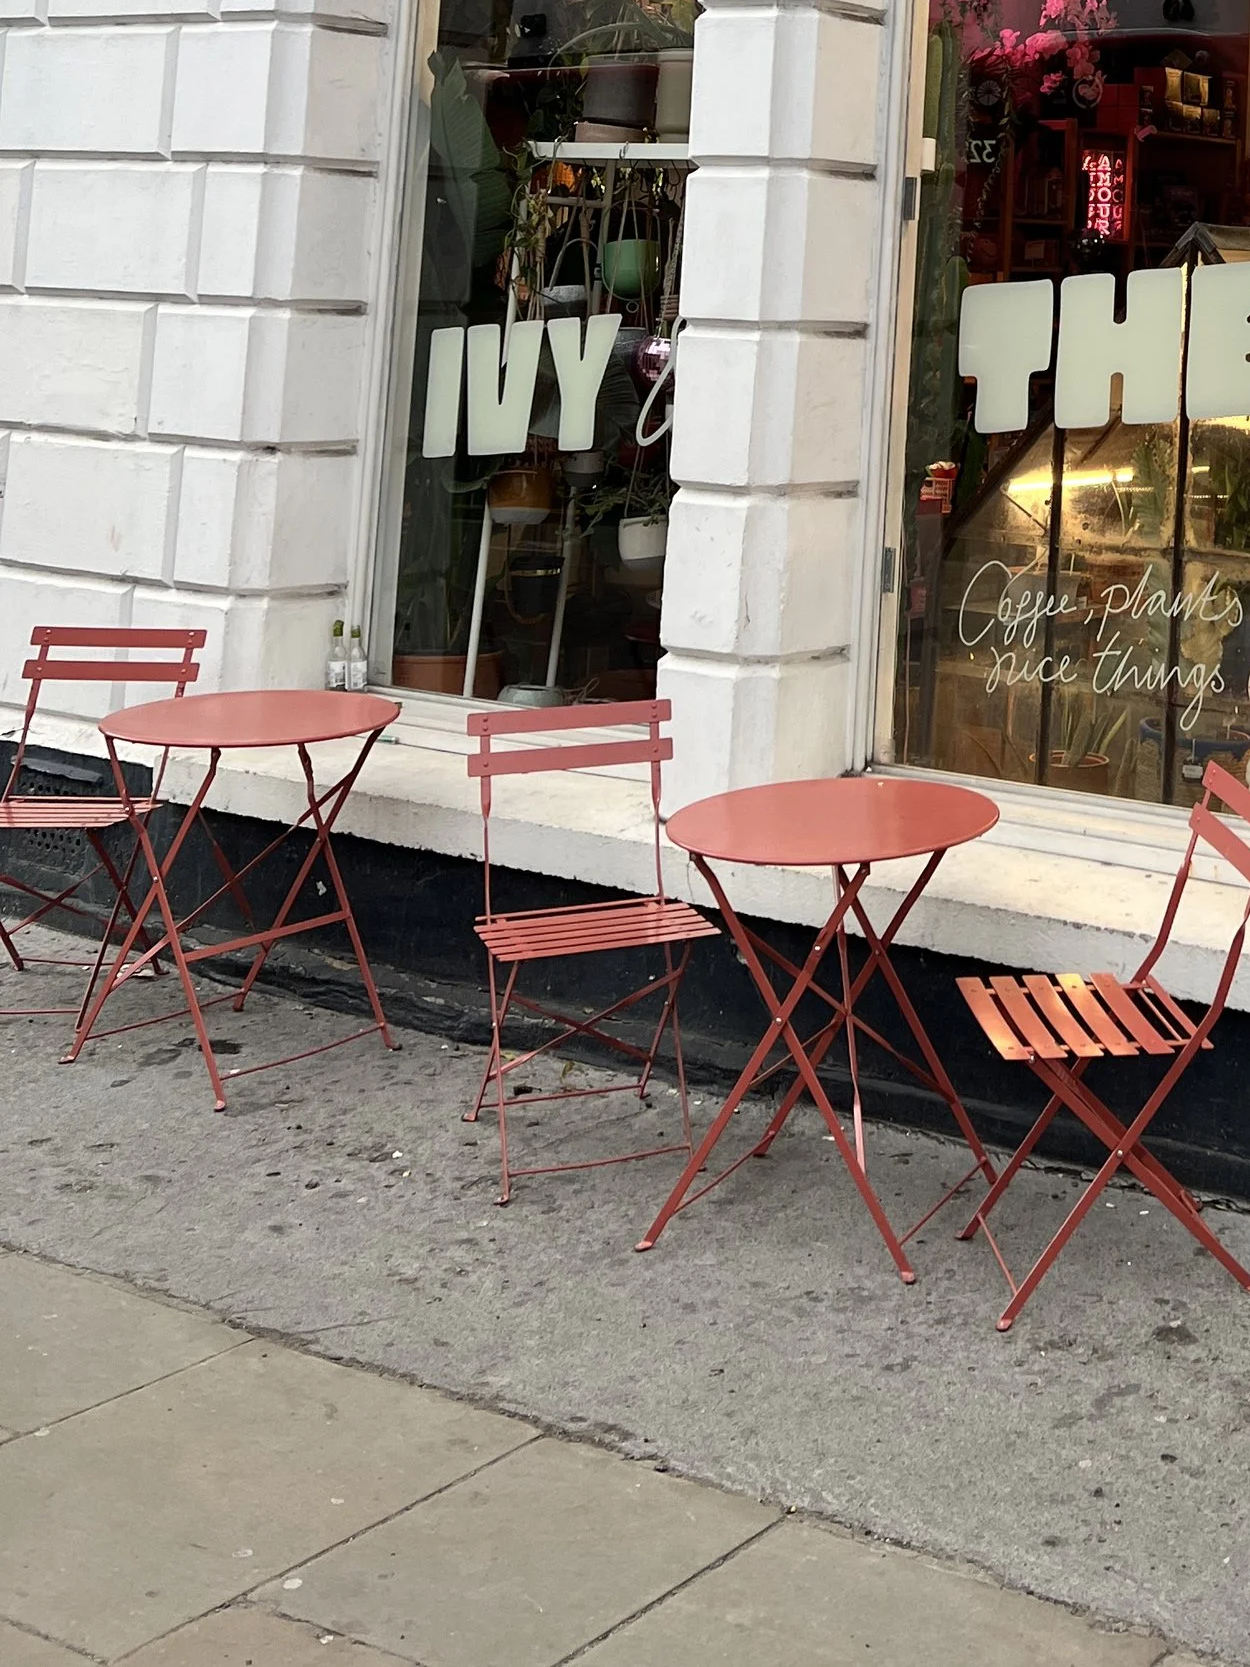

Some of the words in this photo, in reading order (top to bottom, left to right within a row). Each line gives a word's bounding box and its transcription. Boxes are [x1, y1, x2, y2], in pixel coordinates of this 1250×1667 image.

[422, 313, 623, 458] IVY
[1096, 564, 1244, 642] plants
[985, 645, 1079, 693] nice
[1092, 631, 1225, 731] things
